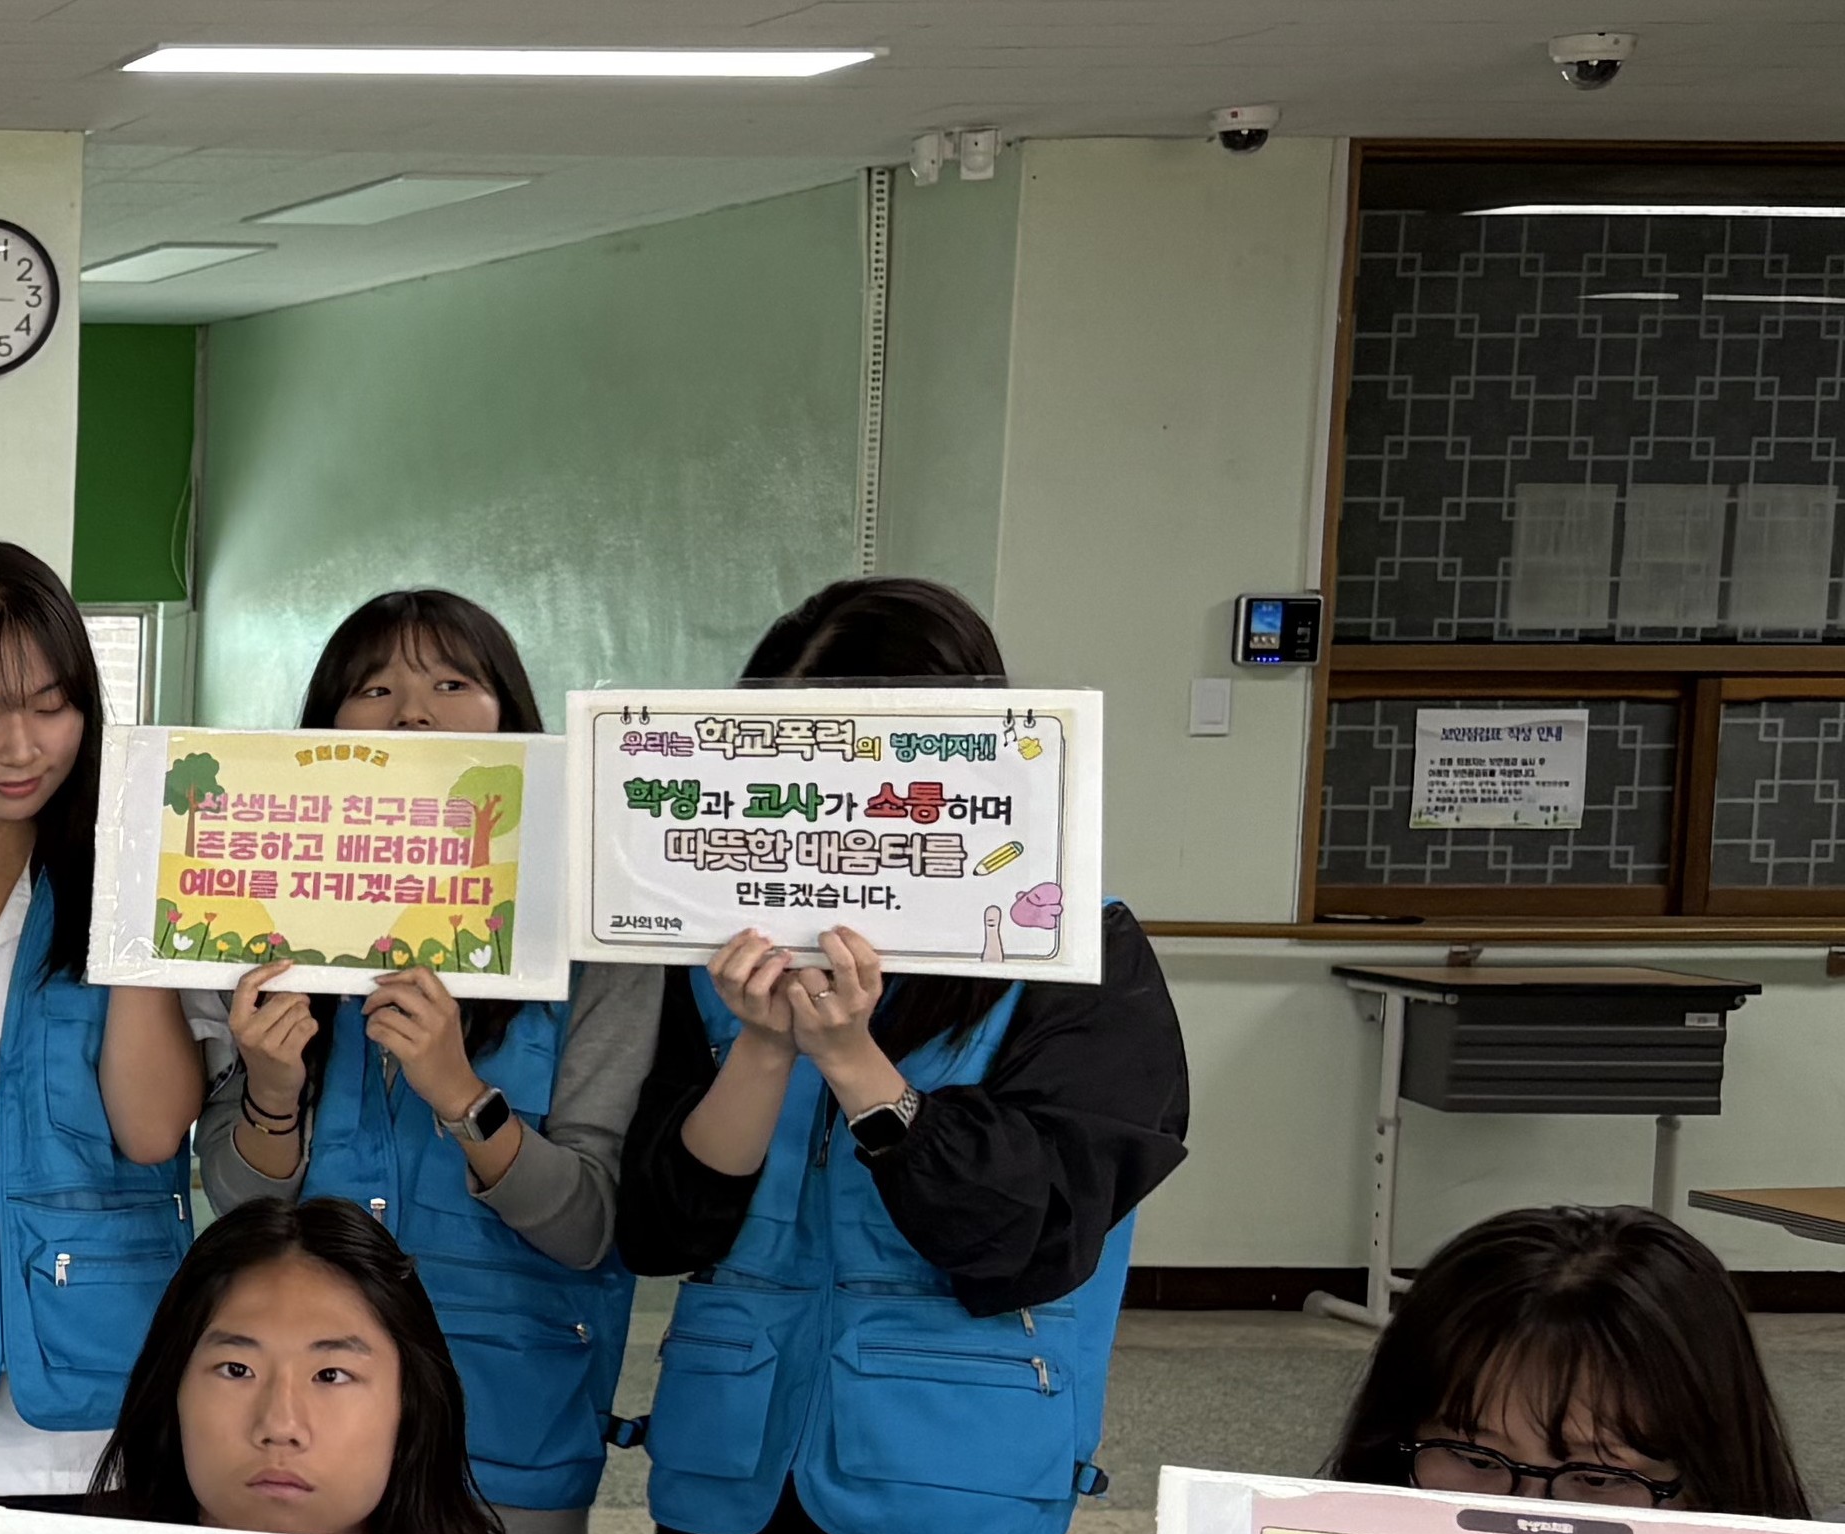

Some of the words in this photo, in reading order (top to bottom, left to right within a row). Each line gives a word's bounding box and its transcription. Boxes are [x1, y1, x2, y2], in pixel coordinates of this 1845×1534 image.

[16, 258, 33, 282] 2
[25, 285, 42, 308] 3
[14, 314, 31, 336] 4
[619, 731, 694, 756] 우리는
[695, 717, 882, 762] 학교폭력의
[889, 732, 997, 762] 방어자!!
[196, 792, 331, 825] 선생님과
[342, 794, 473, 828] 친구들을
[623, 778, 735, 819] 학생과
[742, 782, 858, 823] 교사가
[864, 781, 1011, 825] 소통하며
[196, 831, 324, 862] 존중하고
[336, 834, 471, 867] 배려하며
[665, 827, 792, 872] 따뜻한
[797, 830, 968, 878] 배움터를
[179, 868, 279, 899] 예의를
[290, 871, 493, 906] 지키겠습니다
[736, 882, 901, 911] 만들겠습니다.
